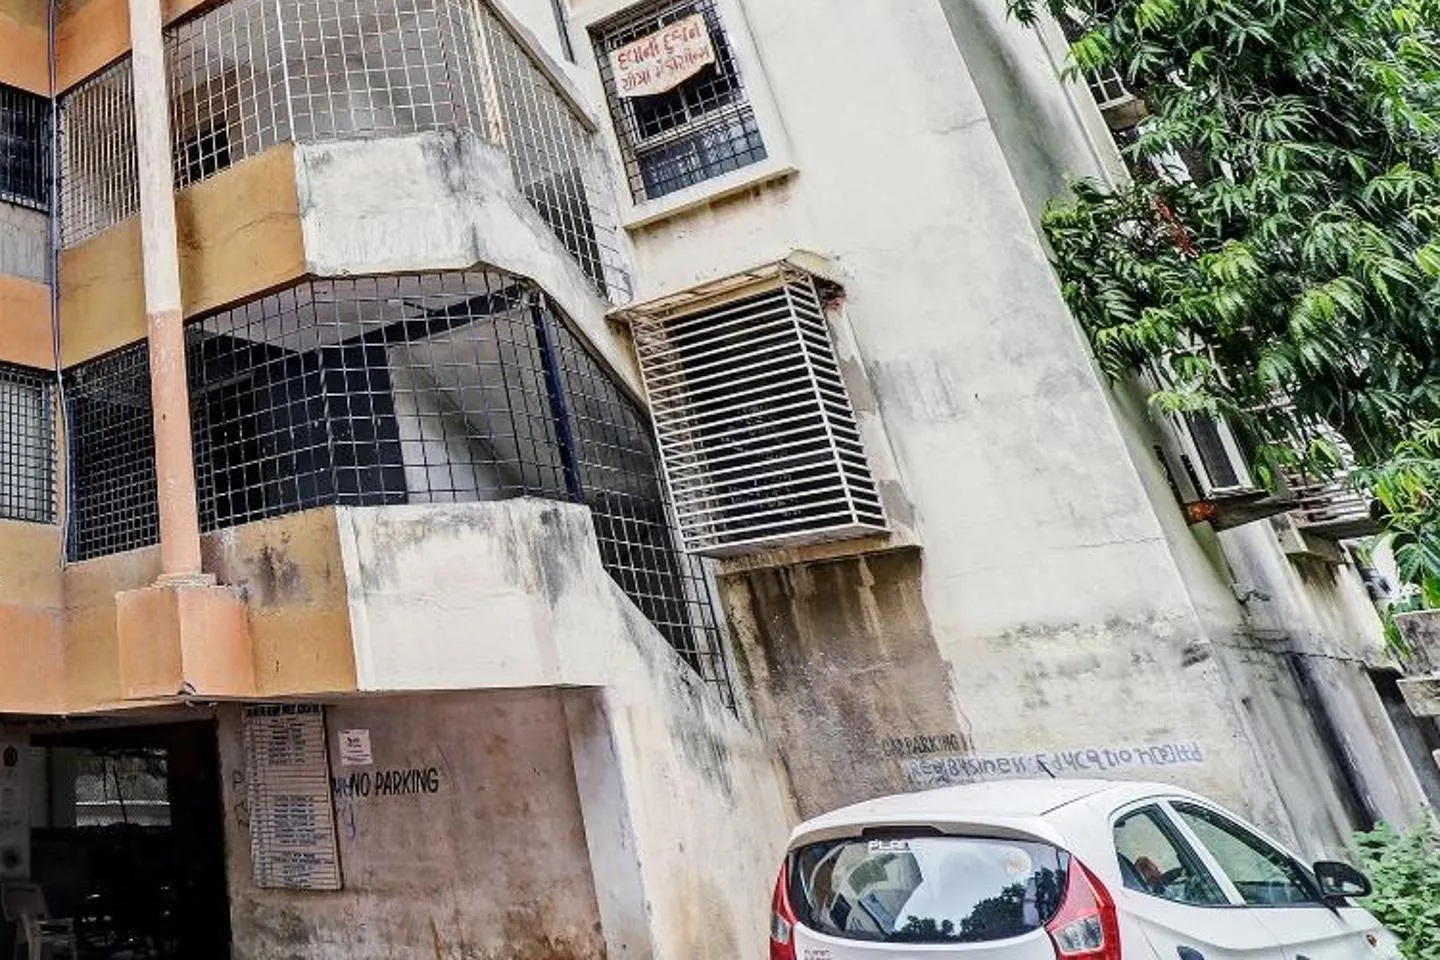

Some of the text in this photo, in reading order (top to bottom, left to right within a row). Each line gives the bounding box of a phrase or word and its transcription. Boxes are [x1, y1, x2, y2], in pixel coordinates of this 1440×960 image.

[906, 734, 959, 754] PARKING
[348, 772, 371, 797] NO
[375, 767, 439, 795] PARKING
